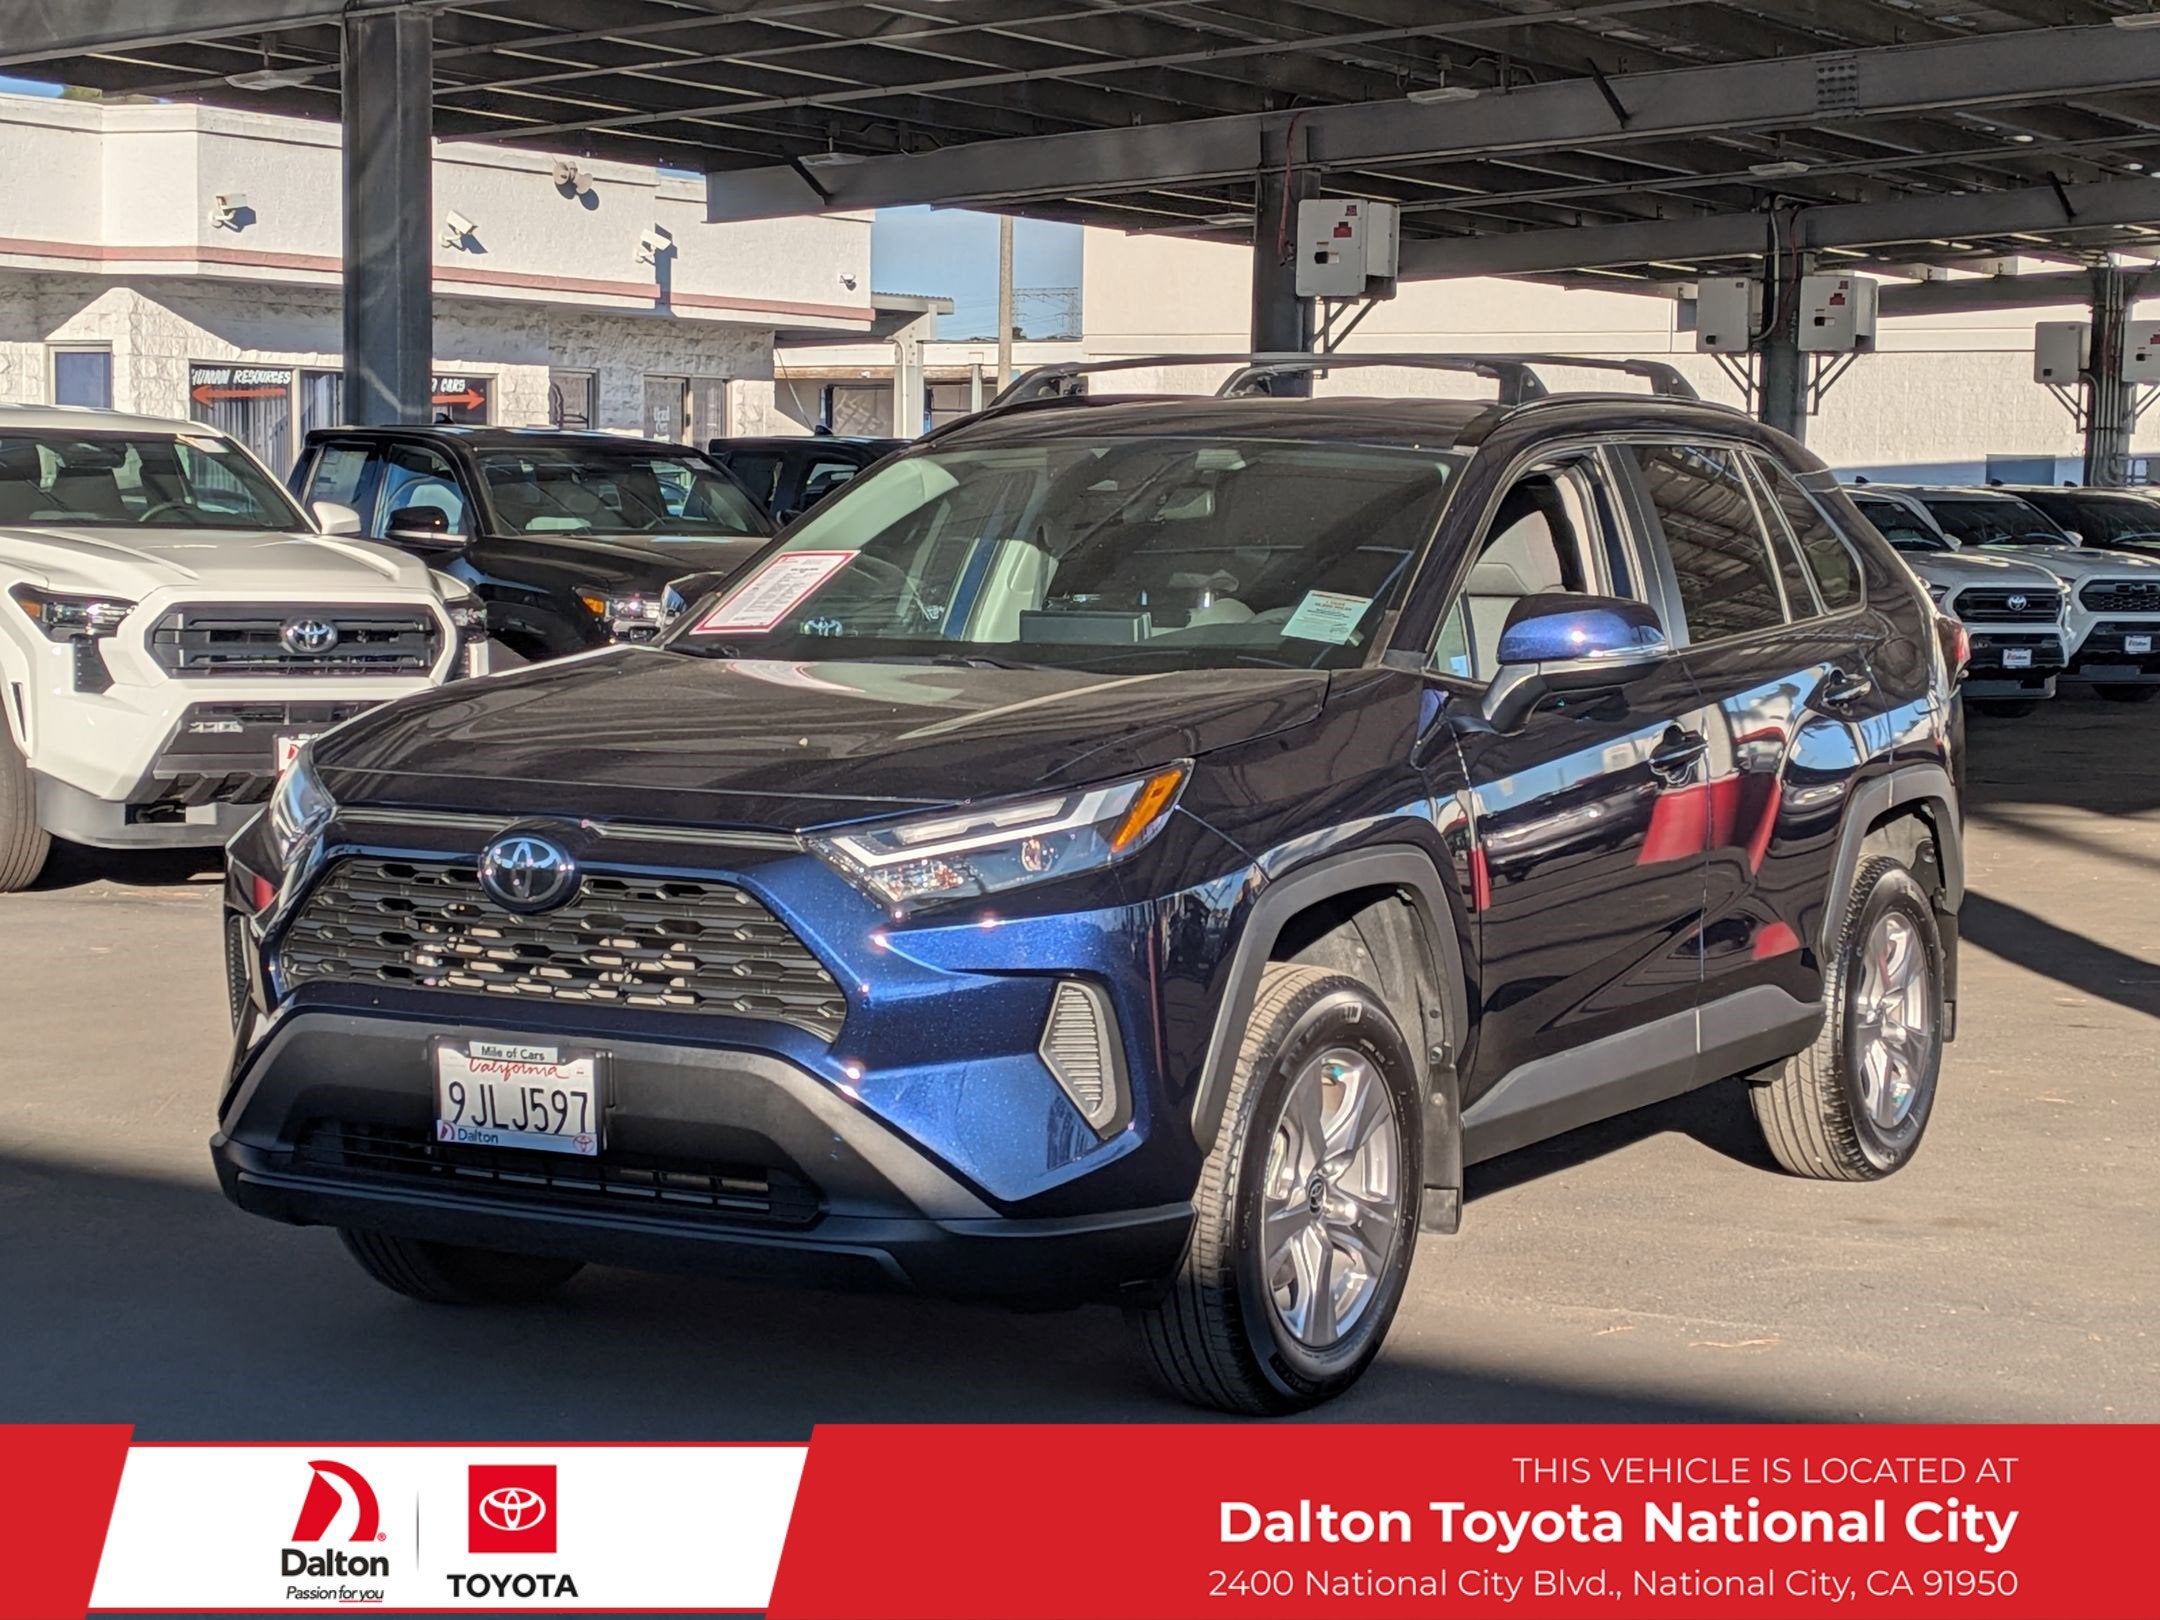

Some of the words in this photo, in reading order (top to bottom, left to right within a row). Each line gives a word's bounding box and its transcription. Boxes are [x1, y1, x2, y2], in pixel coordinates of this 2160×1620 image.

[191, 368, 231, 386] HUMAN
[233, 369, 291, 385] RESOURCES
[440, 378, 466, 393] CARS
[481, 1045, 503, 1058] Mile
[506, 1048, 517, 1060] of
[520, 1048, 545, 1062] Cars
[468, 1056, 569, 1082] California
[448, 1080, 589, 1136] 9JLJ597
[457, 1127, 499, 1144] Dalton
